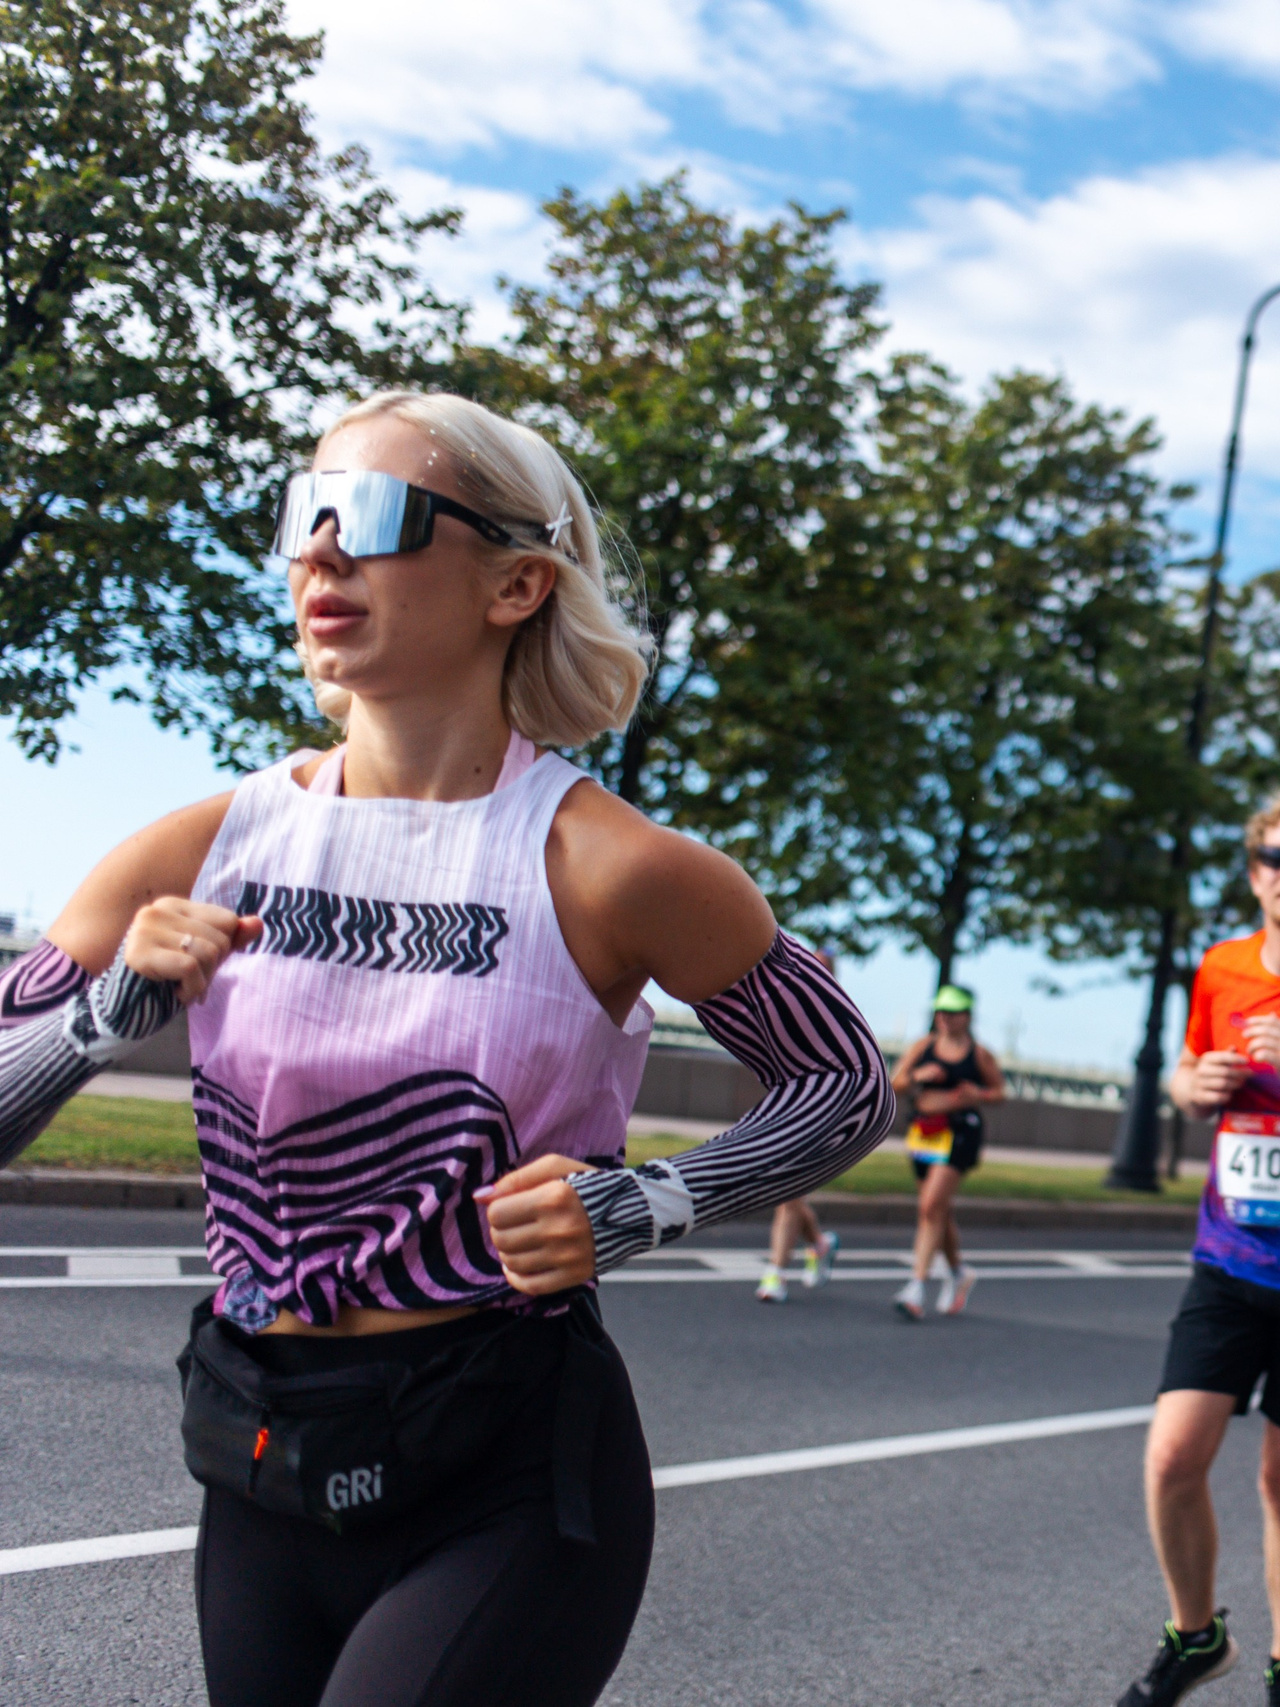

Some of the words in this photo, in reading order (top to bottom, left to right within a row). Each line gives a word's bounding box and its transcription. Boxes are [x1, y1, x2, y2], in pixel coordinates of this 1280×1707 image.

[262, 884, 342, 962] RUN
[336, 895, 399, 971] WE
[392, 902, 509, 978] TRUST
